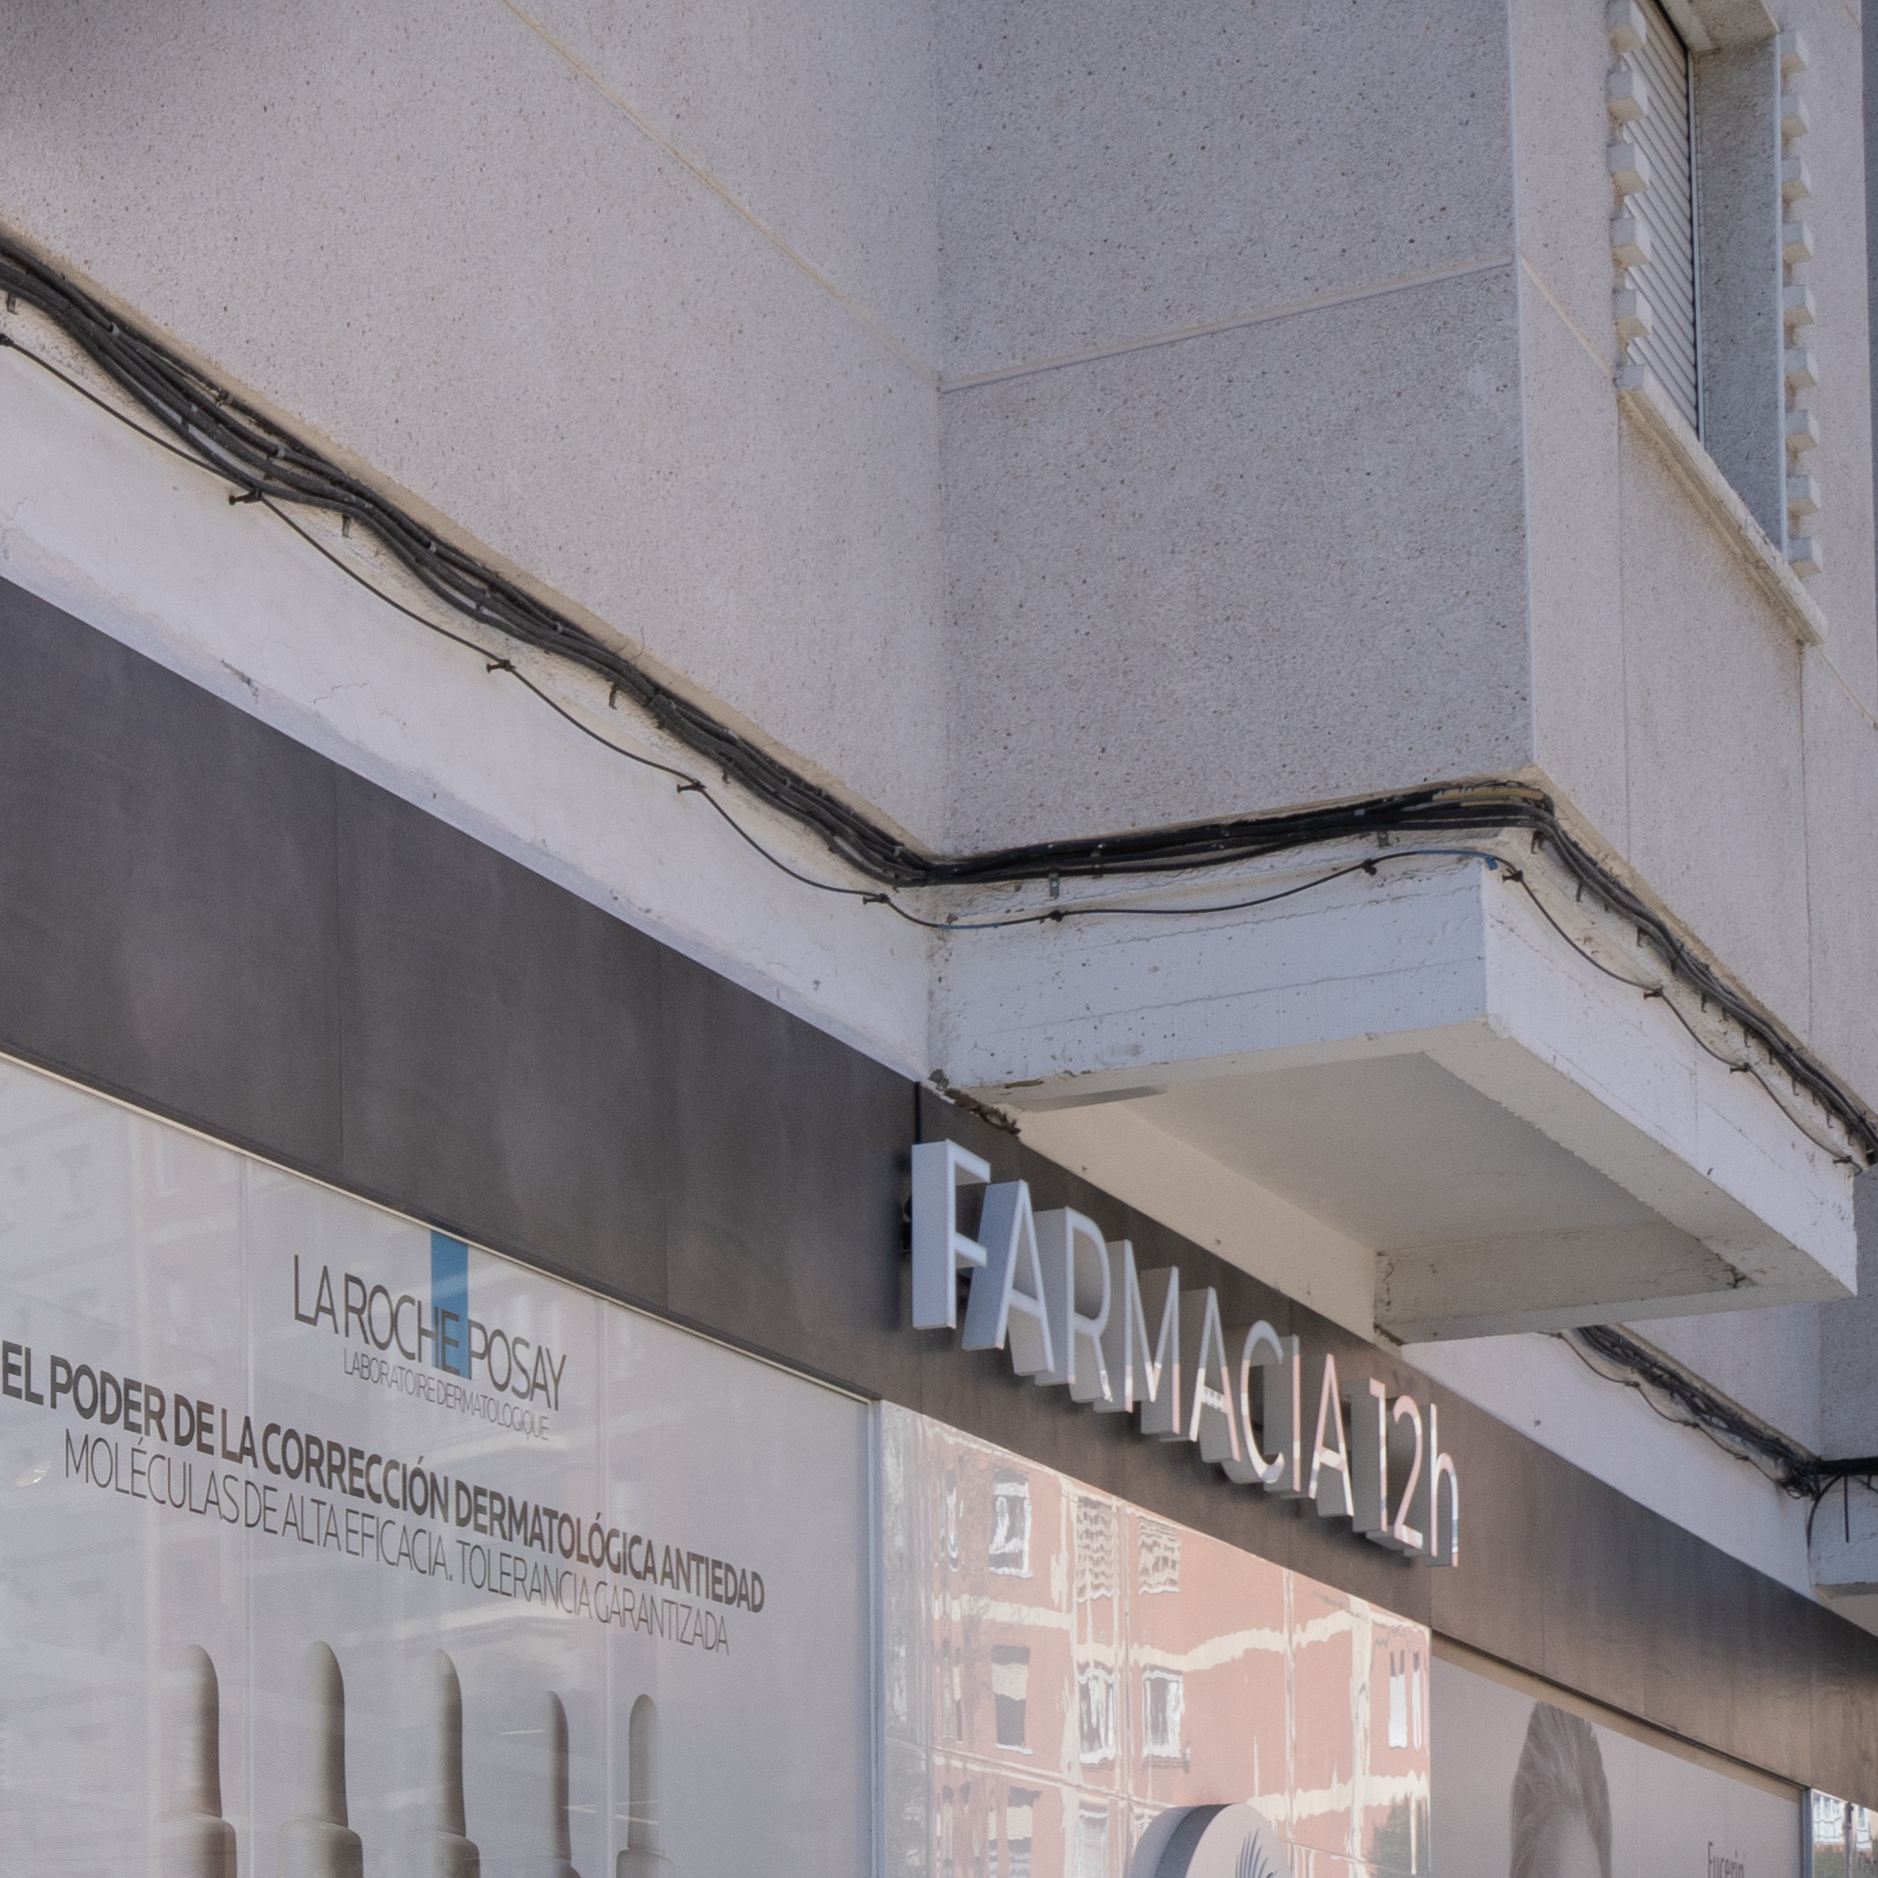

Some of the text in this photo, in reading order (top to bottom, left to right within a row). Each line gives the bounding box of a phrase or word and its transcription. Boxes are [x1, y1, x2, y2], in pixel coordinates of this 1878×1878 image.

[294, 1254, 567, 1411] LA ROCHE POSAY
[343, 1347, 435, 1403] LABORATOIRE
[911, 1138, 1459, 1567] FARMACIA 12h
[1, 1340, 766, 1614] EL PODER DE LA CORRECCIÓN DERMATOLÓGICA ANTIEDAD
[65, 1428, 730, 1656] MOLÉCULAS DE ALTA EFICACIA. TOLERANCIA GARANTIZADA
